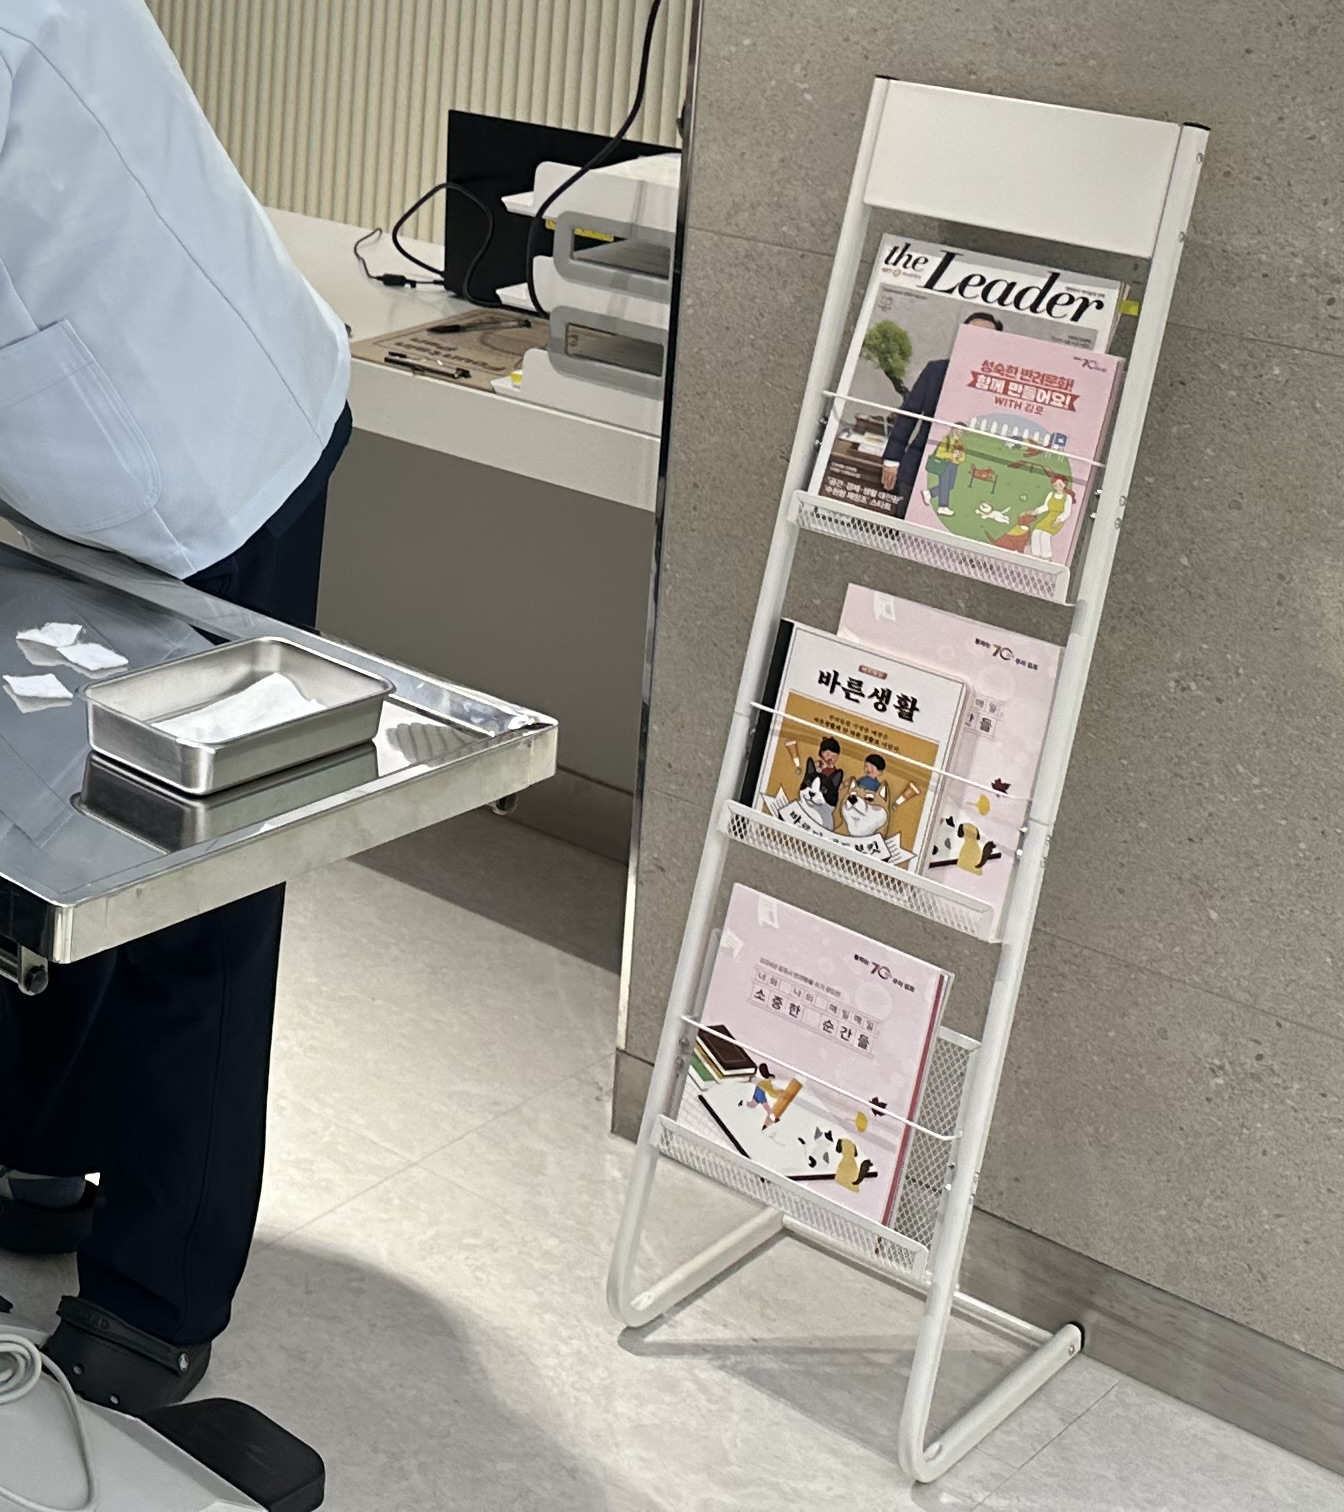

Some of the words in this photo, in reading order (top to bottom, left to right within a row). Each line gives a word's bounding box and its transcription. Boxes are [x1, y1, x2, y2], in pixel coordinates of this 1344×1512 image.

[884, 242, 929, 273] the
[916, 249, 1105, 323] Leader
[981, 359, 1019, 379] 성숙한
[994, 396, 1023, 410] WITH
[818, 669, 920, 723] 바른생활
[753, 988, 801, 1019] 소중한
[822, 1019, 871, 1050] 순간들
